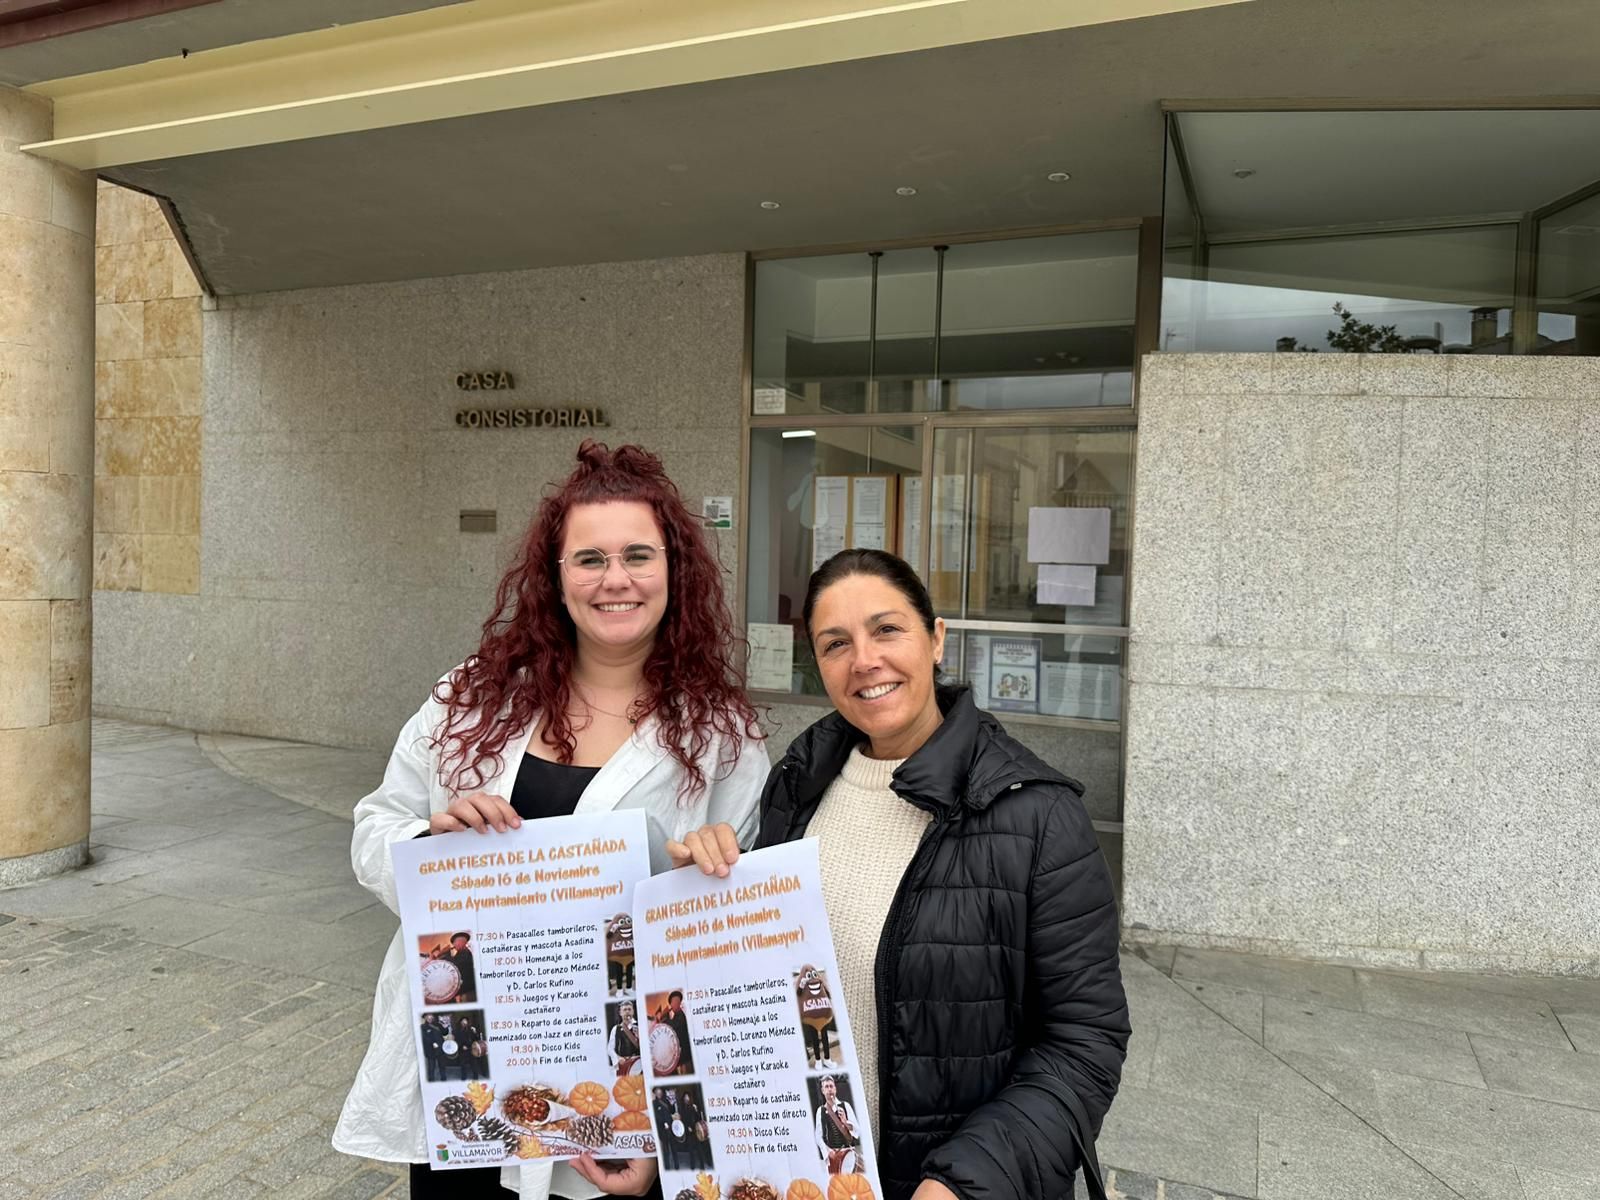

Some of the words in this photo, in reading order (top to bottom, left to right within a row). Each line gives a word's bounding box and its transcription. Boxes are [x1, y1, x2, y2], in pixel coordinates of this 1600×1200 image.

[456, 371, 510, 390] CASA
[455, 408, 606, 428] CONSISTORIAL
[419, 858, 456, 875] GRAN
[459, 853, 505, 869] FIESTA
[508, 851, 525, 865] DE
[528, 848, 545, 863] LA
[549, 837, 626, 860] CASTAÑADA
[451, 874, 495, 890] Sábado
[498, 872, 511, 887] 16
[515, 871, 531, 884] de
[535, 864, 600, 882] Noviembre
[429, 897, 462, 912] Plaza
[466, 890, 547, 911] Ayuntamiento
[551, 880, 624, 901] (Villamayor)
[645, 904, 669, 924] GRAN
[669, 896, 702, 918] FIESTA
[703, 892, 717, 911] DE
[719, 889, 733, 906] LA
[735, 874, 801, 903] CASTAÑADA
[476, 932, 497, 940] 17.30
[506, 929, 545, 939] Pasacalles
[548, 924, 598, 936] tamborileros,
[665, 921, 697, 942] Sábado
[698, 920, 709, 935] 16
[712, 918, 724, 933] de
[727, 907, 781, 929] Noviembre
[482, 944, 521, 954] castañeras
[524, 944, 528, 952] y
[531, 939, 561, 950] mascota
[564, 937, 594, 946] Asadina
[651, 953, 675, 968] Plaza
[676, 942, 739, 966] Ayuntamiento
[742, 925, 805, 951] (Villamayor)
[494, 957, 515, 965] 18.00
[526, 954, 562, 963] Homenaje
[572, 951, 583, 959] los
[480, 969, 525, 979] tamborileros
[527, 968, 535, 976] D.
[538, 966, 568, 975] Lorenzo
[571, 963, 600, 972] Méndez
[507, 983, 511, 992] y
[513, 982, 521, 990] D.
[524, 980, 547, 989] Carlos
[549, 979, 573, 987] Rufino
[687, 990, 703, 1000] 17.30
[705, 988, 709, 997] h
[710, 985, 741, 997] Pasacalles
[744, 979, 787, 991] tamborileros,
[495, 995, 514, 1004] 18.15
[516, 993, 520, 1002] h
[523, 994, 548, 1004] Juegos
[551, 994, 555, 1002] y
[558, 990, 588, 1000] Karaoke
[693, 1003, 724, 1015] castañeras
[726, 1004, 730, 1013] y
[732, 999, 758, 1009] mascota
[761, 994, 786, 1004] Asadina
[524, 1005, 560, 1014] castañero
[491, 1021, 512, 1029] 18.30
[515, 1020, 519, 1028] h
[522, 1018, 550, 1029] Reparto
[565, 1014, 597, 1024] castañas
[703, 1019, 721, 1029] 18.00
[722, 1018, 727, 1027] h
[728, 1014, 760, 1026] Homenaje
[768, 1012, 778, 1020] los
[489, 1032, 527, 1042] amenizado
[529, 1032, 542, 1040] con
[544, 1031, 560, 1039] Jazz
[575, 1027, 601, 1037] directo
[693, 1035, 730, 1046] tamborileros
[732, 1032, 738, 1041] D.
[741, 1031, 766, 1040] Lorenzo
[769, 1026, 795, 1037] Méndez
[511, 1045, 533, 1053] 19.30
[535, 1044, 539, 1052] h
[542, 1044, 562, 1052] Disco
[565, 1042, 581, 1050] Kids
[716, 1052, 720, 1061] y
[721, 1049, 728, 1059] D.
[731, 1047, 750, 1058] Carlos
[752, 1045, 773, 1055] Rufino
[507, 1058, 533, 1067] 20.00
[533, 1057, 537, 1065] h
[540, 1056, 551, 1065] Fin
[565, 1054, 587, 1062] fiesta
[708, 1065, 724, 1076] 18.15
[726, 1065, 729, 1074] h
[731, 1064, 753, 1075] Juegos
[755, 1064, 759, 1074] y
[761, 1060, 788, 1071] Karaoke
[734, 1078, 765, 1089] castañero
[708, 1097, 726, 1107] 18.30
[728, 1097, 732, 1105] h
[733, 1096, 758, 1107] Reparto
[761, 1095, 768, 1104] de
[771, 1091, 800, 1103] castañas
[709, 1113, 739, 1122] amenizado
[742, 1113, 752, 1121] con
[755, 1110, 769, 1120] Jazz
[772, 1111, 780, 1119] en
[782, 1109, 807, 1118] directo
[728, 1128, 747, 1137] 19.30
[748, 1128, 752, 1136] h
[754, 1127, 772, 1137] Disco
[774, 1126, 789, 1136] Kids
[451, 1148, 502, 1158] VILLAMAYOR
[726, 1144, 747, 1153] 20.00
[748, 1143, 752, 1152] h
[754, 1143, 765, 1152] Fin
[767, 1143, 775, 1152] de
[777, 1142, 798, 1152] fiesta
